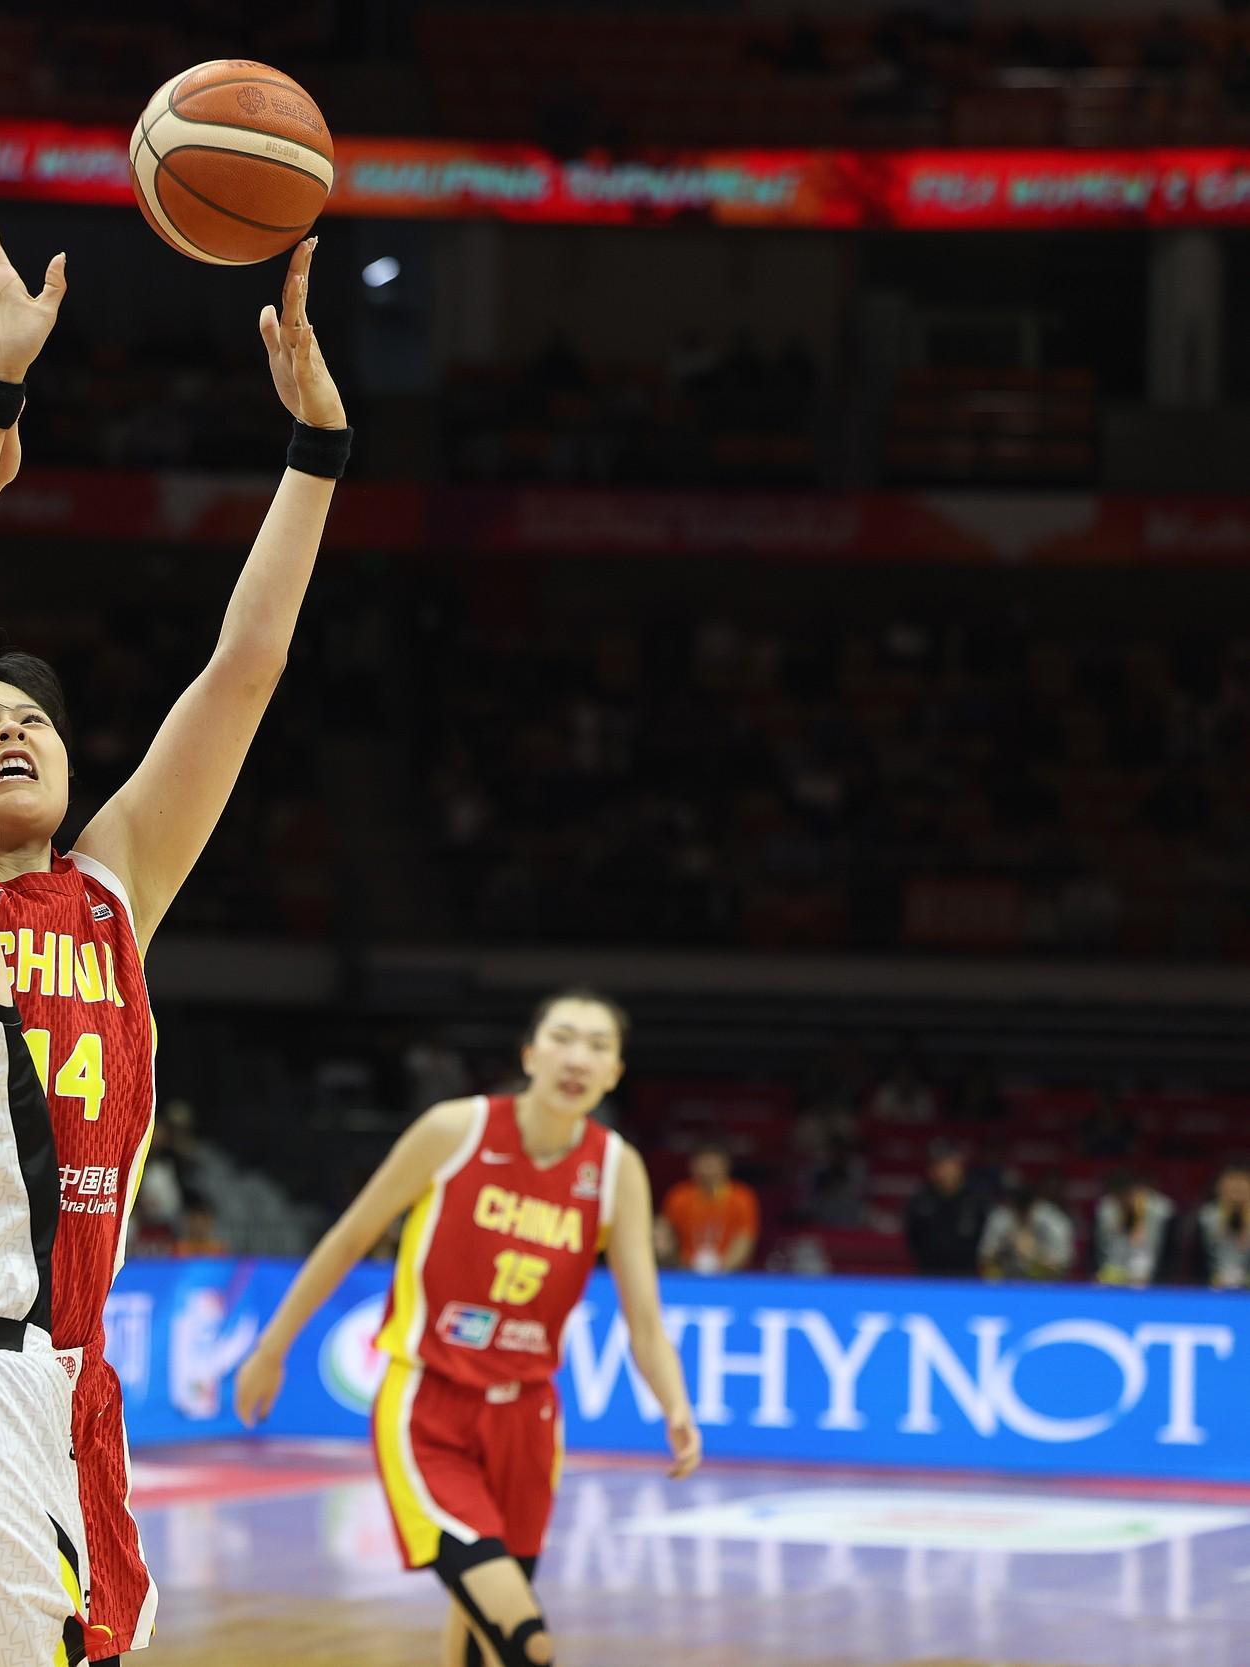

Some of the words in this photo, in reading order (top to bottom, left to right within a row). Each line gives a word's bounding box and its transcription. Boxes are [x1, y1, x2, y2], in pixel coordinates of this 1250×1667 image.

[22, 1028, 106, 1121] 14
[59, 1193, 86, 1214] hina
[474, 1184, 583, 1253] CHINA
[490, 1248, 549, 1305] 15
